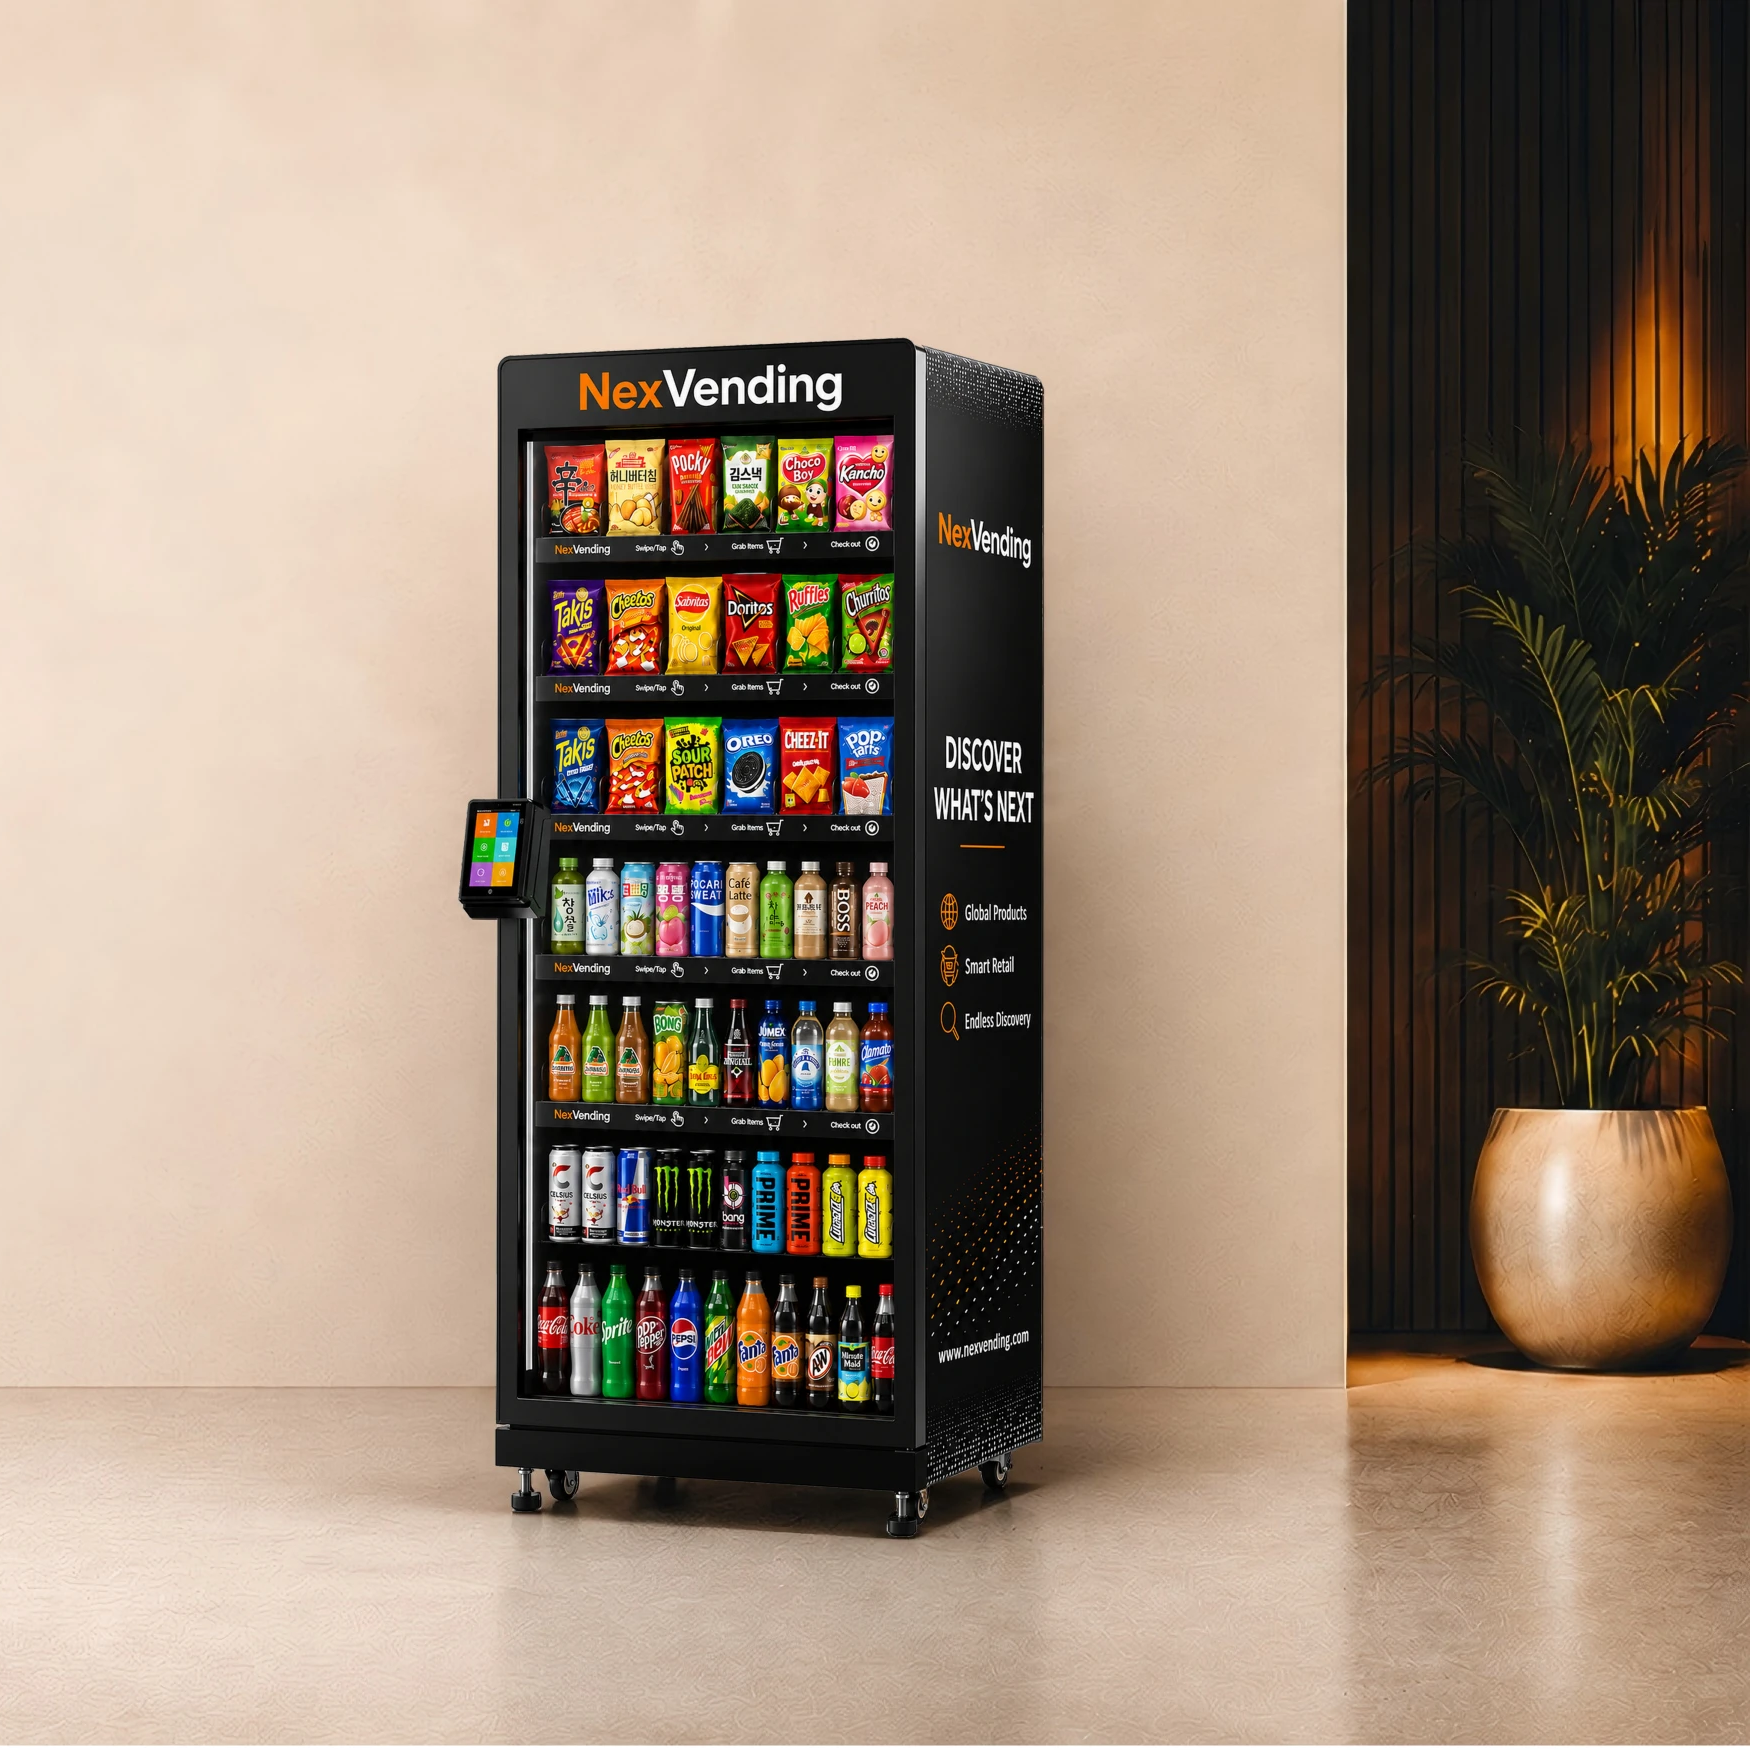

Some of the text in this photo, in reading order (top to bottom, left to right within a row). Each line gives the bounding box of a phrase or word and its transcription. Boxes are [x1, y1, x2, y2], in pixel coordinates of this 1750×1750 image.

[579, 363, 843, 412] NexVending
[785, 456, 821, 471] Choco
[793, 469, 814, 483] Boy
[839, 465, 885, 483] Kancho
[830, 540, 861, 549] Check out
[938, 511, 1032, 569] NexVending
[554, 544, 611, 556] NexVending
[611, 590, 655, 620] Cheetos
[675, 596, 709, 607] Sabritas
[788, 586, 829, 614] Ruffles
[846, 584, 891, 617] Churritos
[554, 599, 593, 632] Takis
[728, 601, 773, 616] Doritos
[554, 683, 611, 695] NexVending
[731, 683, 746, 691] Grab
[830, 682, 861, 691] Check out
[611, 730, 654, 759] Cheetos
[725, 733, 774, 753] OREO
[555, 738, 596, 772] Takis
[672, 746, 712, 765] SOUR
[945, 735, 1023, 774] DISCOVER
[671, 762, 713, 781] PATCH
[933, 786, 1035, 823] WHAT'S NEXT
[554, 822, 611, 834] NexVending
[830, 824, 861, 833] Check out
[728, 878, 751, 889] Café
[729, 890, 752, 900] Latte
[837, 889, 850, 932] BOSS
[865, 902, 889, 911] PEACH
[965, 903, 1028, 921] Global Products
[554, 962, 611, 976] NexVending
[731, 967, 746, 975] Grab
[965, 955, 1015, 975] Smart Retail
[830, 969, 861, 978] Check out
[654, 1015, 682, 1033] BONG
[965, 1010, 1032, 1030] Endless Discovery
[758, 1026, 787, 1037] JUMEX
[554, 1109, 611, 1123] NexVending
[731, 1117, 746, 1126] Grab
[830, 1121, 861, 1130] Check out
[550, 1190, 574, 1199] CELSIUS
[583, 1192, 608, 1200] CELSIUS
[632, 1184, 647, 1194] Bull
[756, 1177, 776, 1241] PRIME
[791, 1178, 811, 1242] PRIME
[722, 1211, 745, 1224] bang
[602, 1317, 633, 1345] Sprite
[672, 1334, 696, 1344] PEPSI
[938, 1329, 1030, 1364] www.nexvending.com
[738, 1339, 767, 1363] Fanta
[772, 1345, 799, 1367] Fanta
[843, 1359, 861, 1368] Maid
